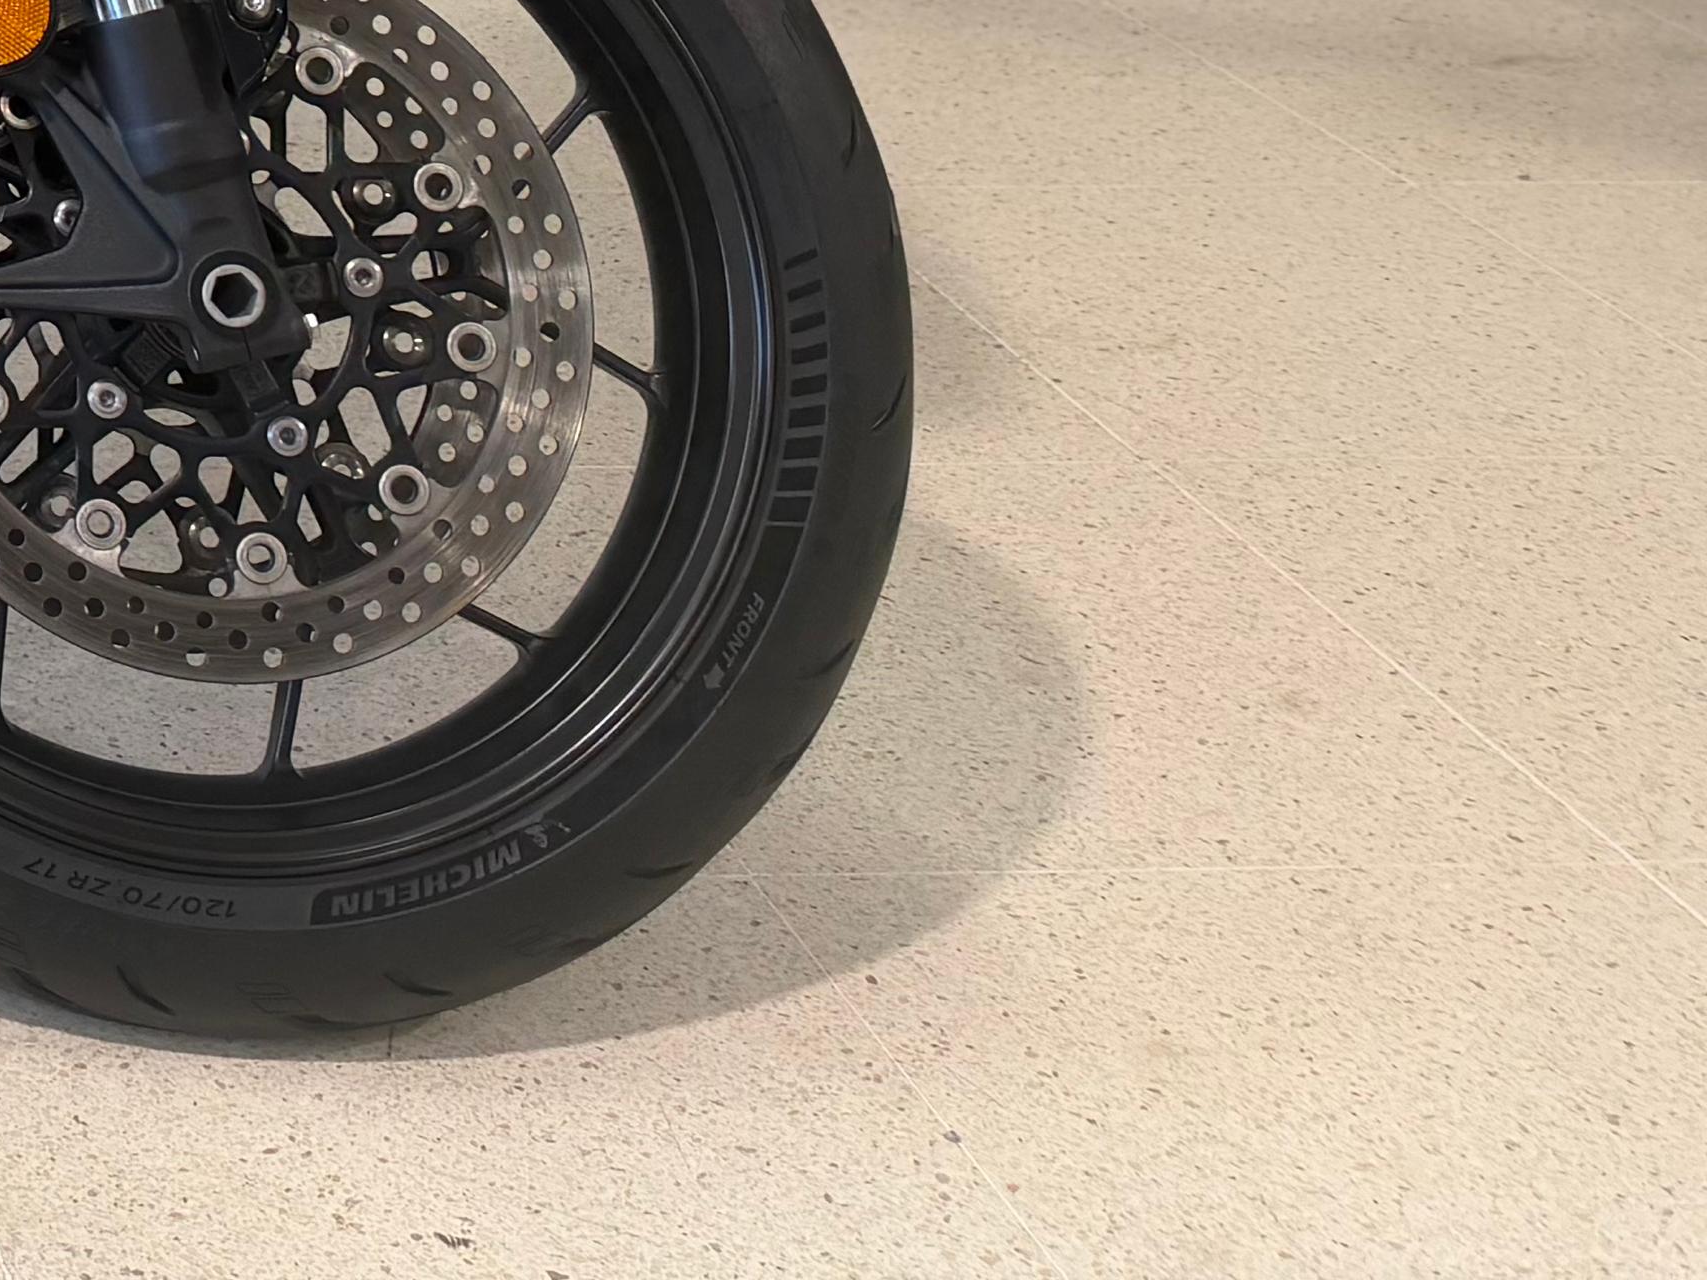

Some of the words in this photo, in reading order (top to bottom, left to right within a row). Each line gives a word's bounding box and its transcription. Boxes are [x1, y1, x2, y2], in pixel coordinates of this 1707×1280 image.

[722, 591, 765, 669] FRONT
[22, 857, 58, 880] 17
[66, 870, 112, 897] ZR
[330, 839, 522, 917] MICHELIN
[122, 886, 237, 919] 120/70
